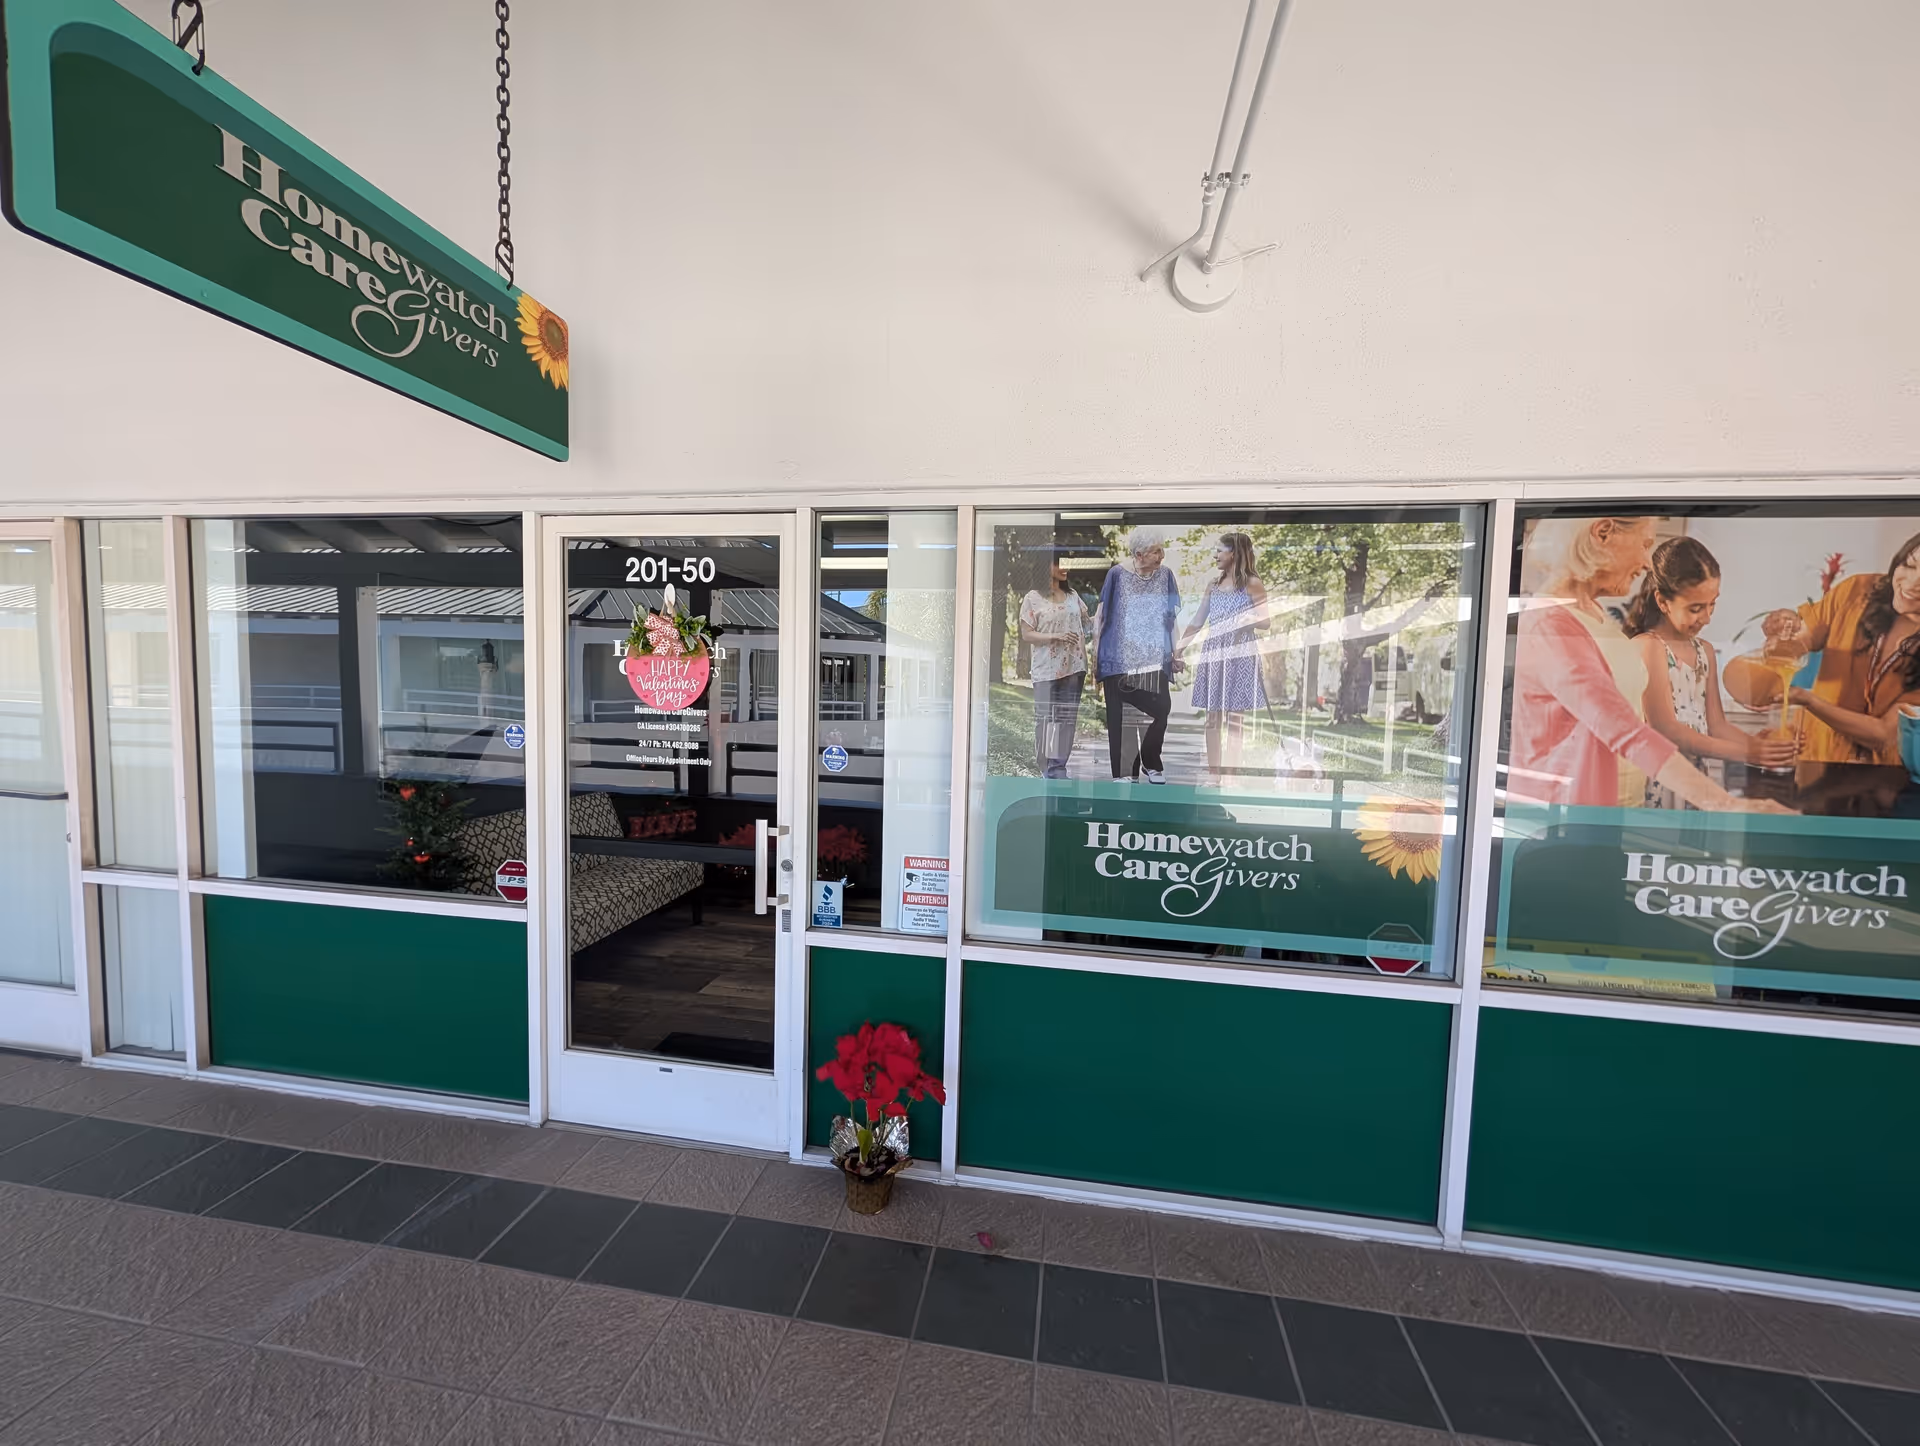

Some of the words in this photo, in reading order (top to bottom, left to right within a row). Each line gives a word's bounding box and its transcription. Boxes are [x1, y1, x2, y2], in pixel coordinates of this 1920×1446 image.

[212, 123, 510, 344] Homewatch
[240, 197, 500, 369] CareGivers
[625, 557, 716, 583] 201-50
[651, 659, 691, 677] HAPPY
[637, 673, 700, 693] Valentine's
[650, 690, 687, 708] Day
[637, 722, 645, 730] CA
[645, 722, 665, 731] License
[638, 739, 652, 748] 24/7
[625, 754, 642, 763] Office
[643, 755, 658, 763] Hours
[658, 756, 665, 764] By
[665, 756, 699, 765] Appointment
[699, 758, 712, 767] Only
[1083, 821, 1314, 863] Homewatch
[909, 858, 947, 869] WARNING
[1094, 851, 1301, 918] CareGivers
[1621, 852, 1908, 898] Homewatch
[817, 905, 836, 913] BBB
[906, 894, 948, 905] ADVERTENCIA
[1634, 886, 1891, 960] CareGivers
